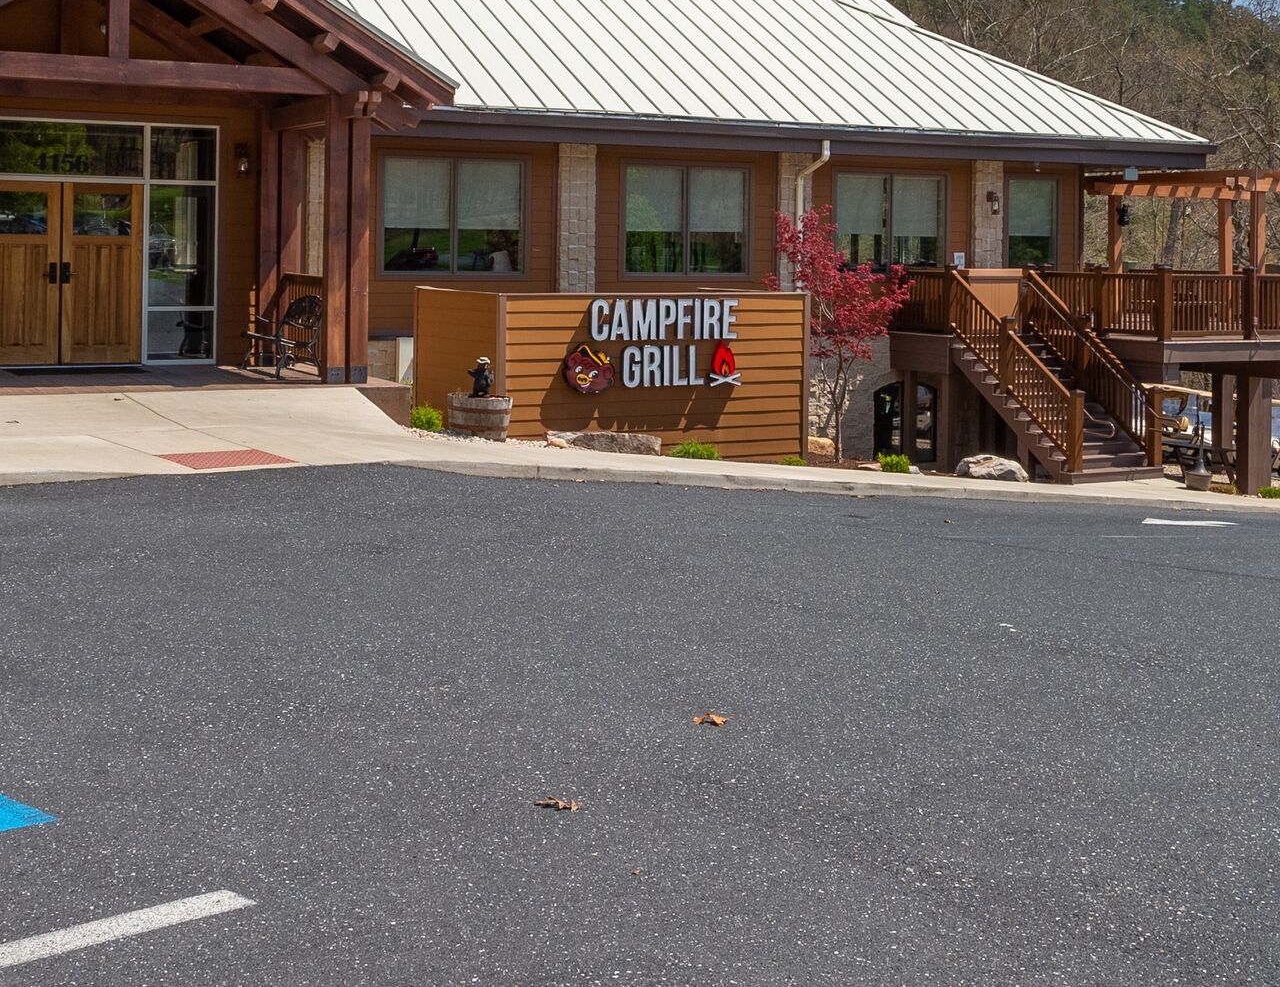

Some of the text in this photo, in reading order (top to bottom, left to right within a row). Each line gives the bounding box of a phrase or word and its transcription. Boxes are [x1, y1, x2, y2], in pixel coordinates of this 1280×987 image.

[33, 153, 89, 172] 4156
[590, 298, 739, 341] CAMPFIRE
[622, 344, 705, 388] GRILL
